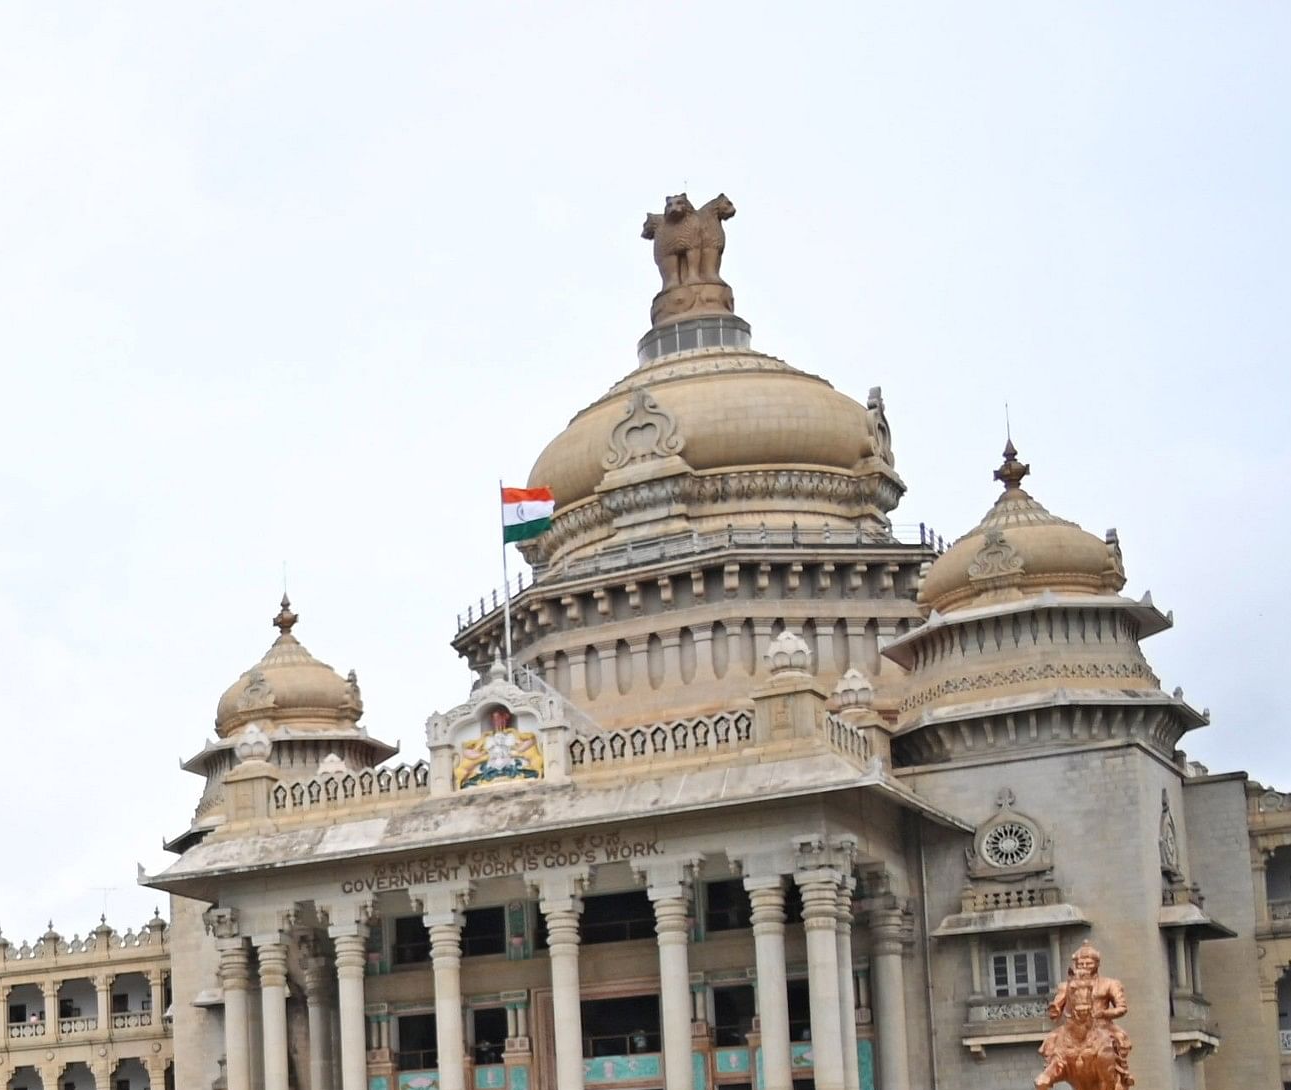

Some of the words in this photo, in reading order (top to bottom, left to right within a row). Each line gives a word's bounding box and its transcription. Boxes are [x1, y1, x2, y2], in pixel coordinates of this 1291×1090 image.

[341, 867, 462, 895] GOVERNMENT
[468, 856, 517, 877] WORK
[523, 856, 539, 871] IS
[544, 851, 597, 869] GOD'S
